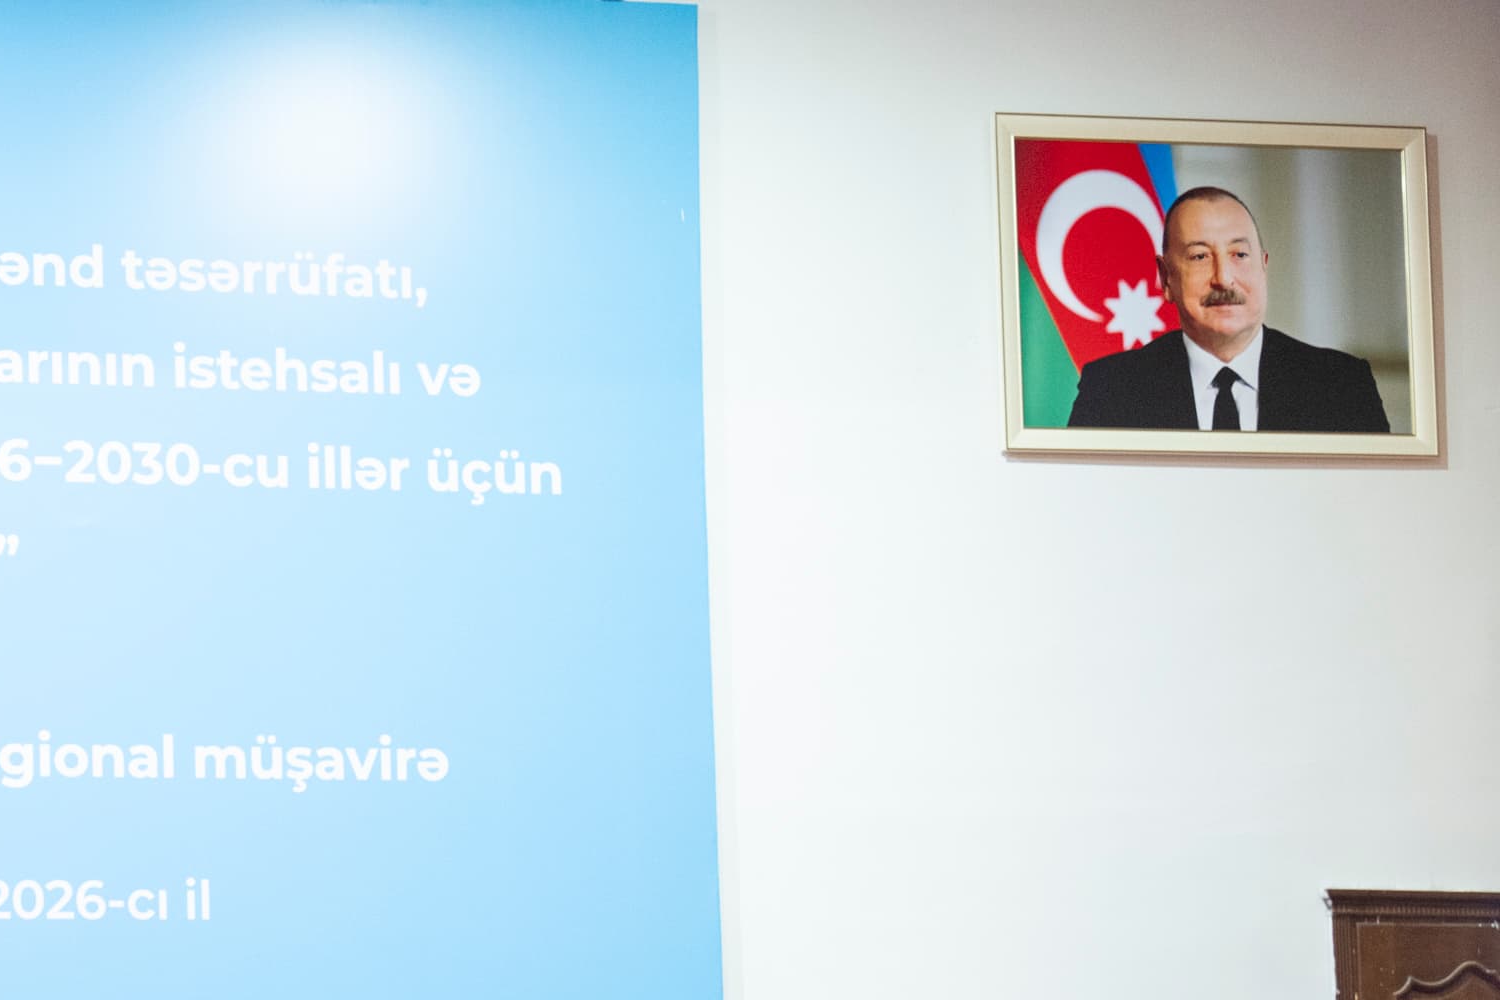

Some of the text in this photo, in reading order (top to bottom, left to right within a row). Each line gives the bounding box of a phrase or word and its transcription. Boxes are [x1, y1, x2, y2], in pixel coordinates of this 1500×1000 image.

[120, 249, 428, 308] təsərrüfatı,
[173, 341, 401, 395] istehsalı
[416, 361, 481, 397] və
[307, 442, 410, 491] illər
[427, 447, 562, 506] üçün
[194, 734, 449, 793] müşavirə
[185, 877, 210, 921] il
